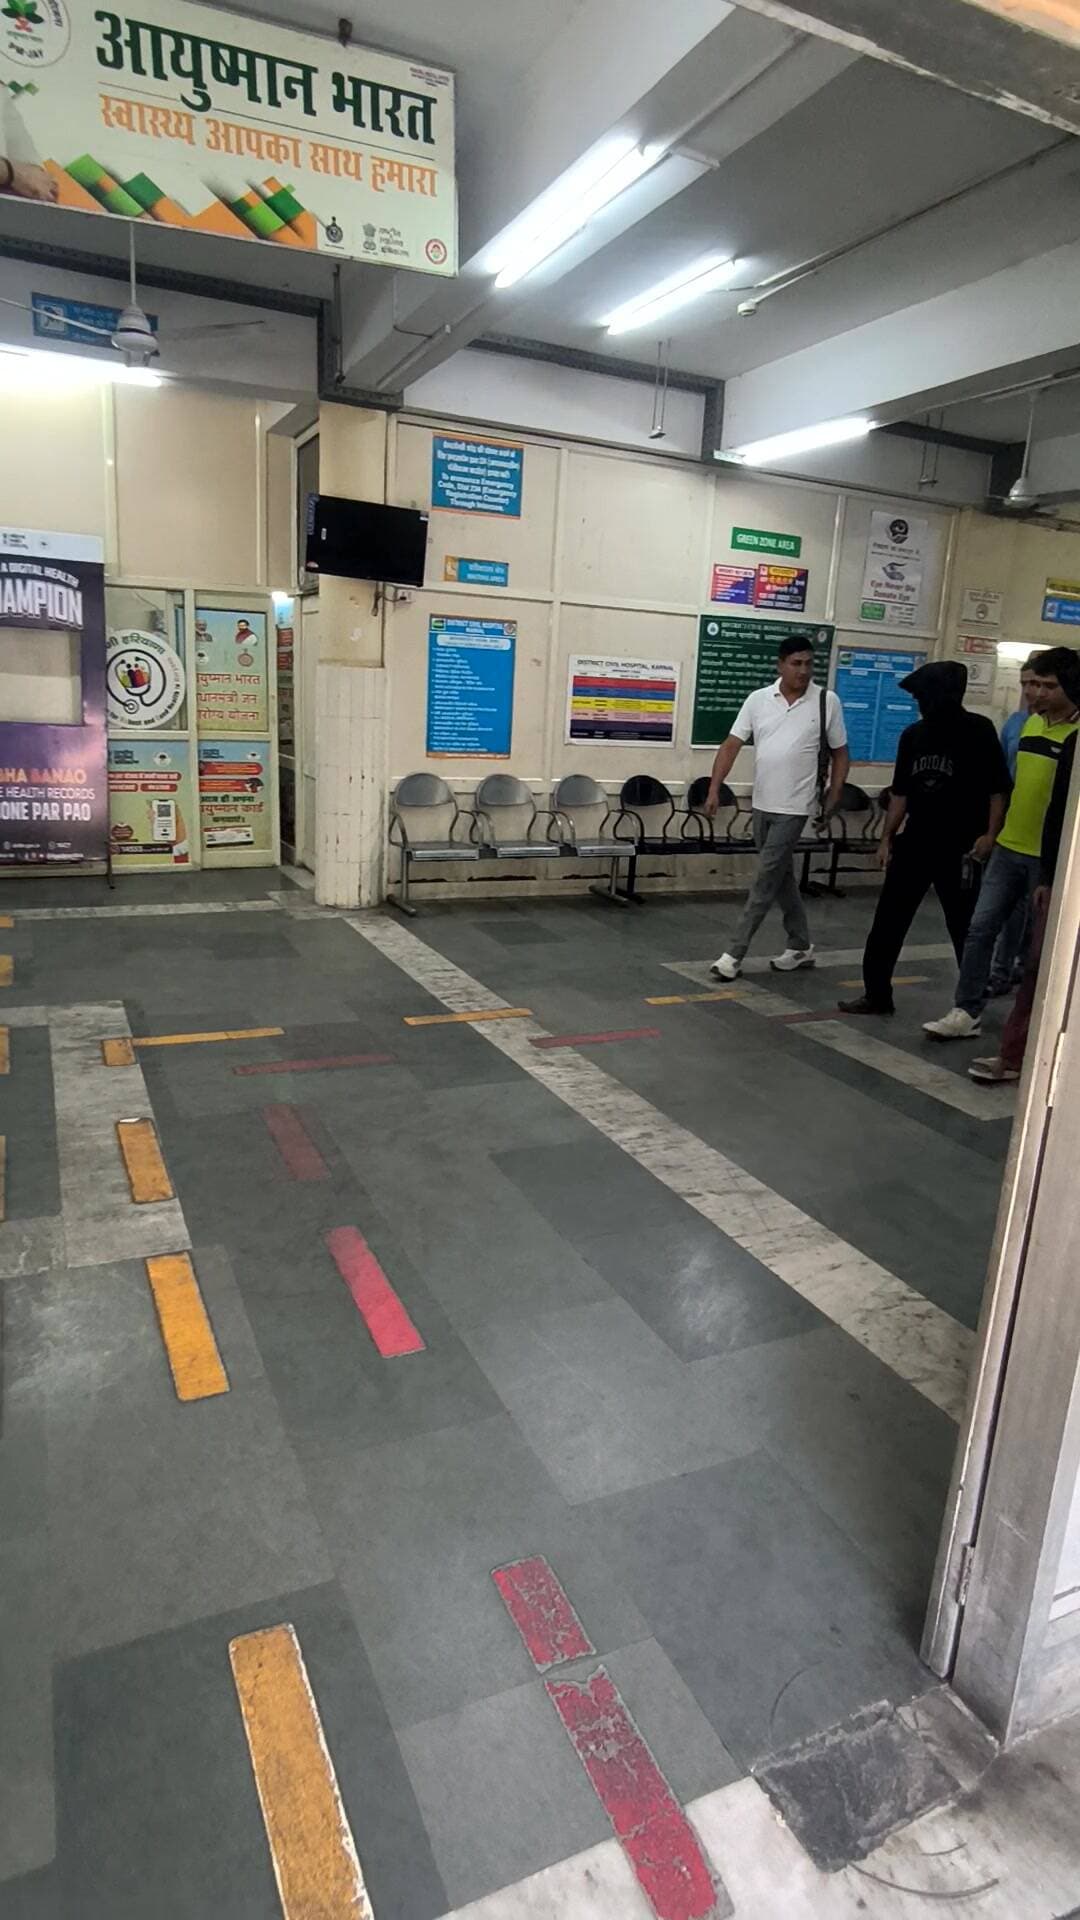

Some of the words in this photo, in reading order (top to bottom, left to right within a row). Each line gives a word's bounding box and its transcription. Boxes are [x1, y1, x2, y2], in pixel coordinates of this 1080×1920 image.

[94, 10, 319, 117] आयुष्मान
[332, 71, 438, 145] भारत
[99, 93, 197, 146] स्वास्थ्य
[205, 117, 302, 169] आपका
[309, 141, 364, 181] साथ
[370, 155, 439, 198] हमारा
[736, 533, 759, 545] GREEN
[759, 537, 777, 548] ZONE
[778, 540, 795, 550] AREA
[9, 562, 42, 576] DIGITAL
[43, 566, 80, 588] HEALTH
[577, 659, 604, 667] DISTRICT
[235, 674, 261, 685] भारत
[242, 693, 257, 704] जन
[227, 708, 259, 721] योजना
[911, 754, 953, 777] ADIDAS
[6, 786, 46, 799] HEALTH
[47, 787, 96, 800] RECORDS
[32, 802, 60, 821] PAR
[63, 802, 92, 822] PAO
